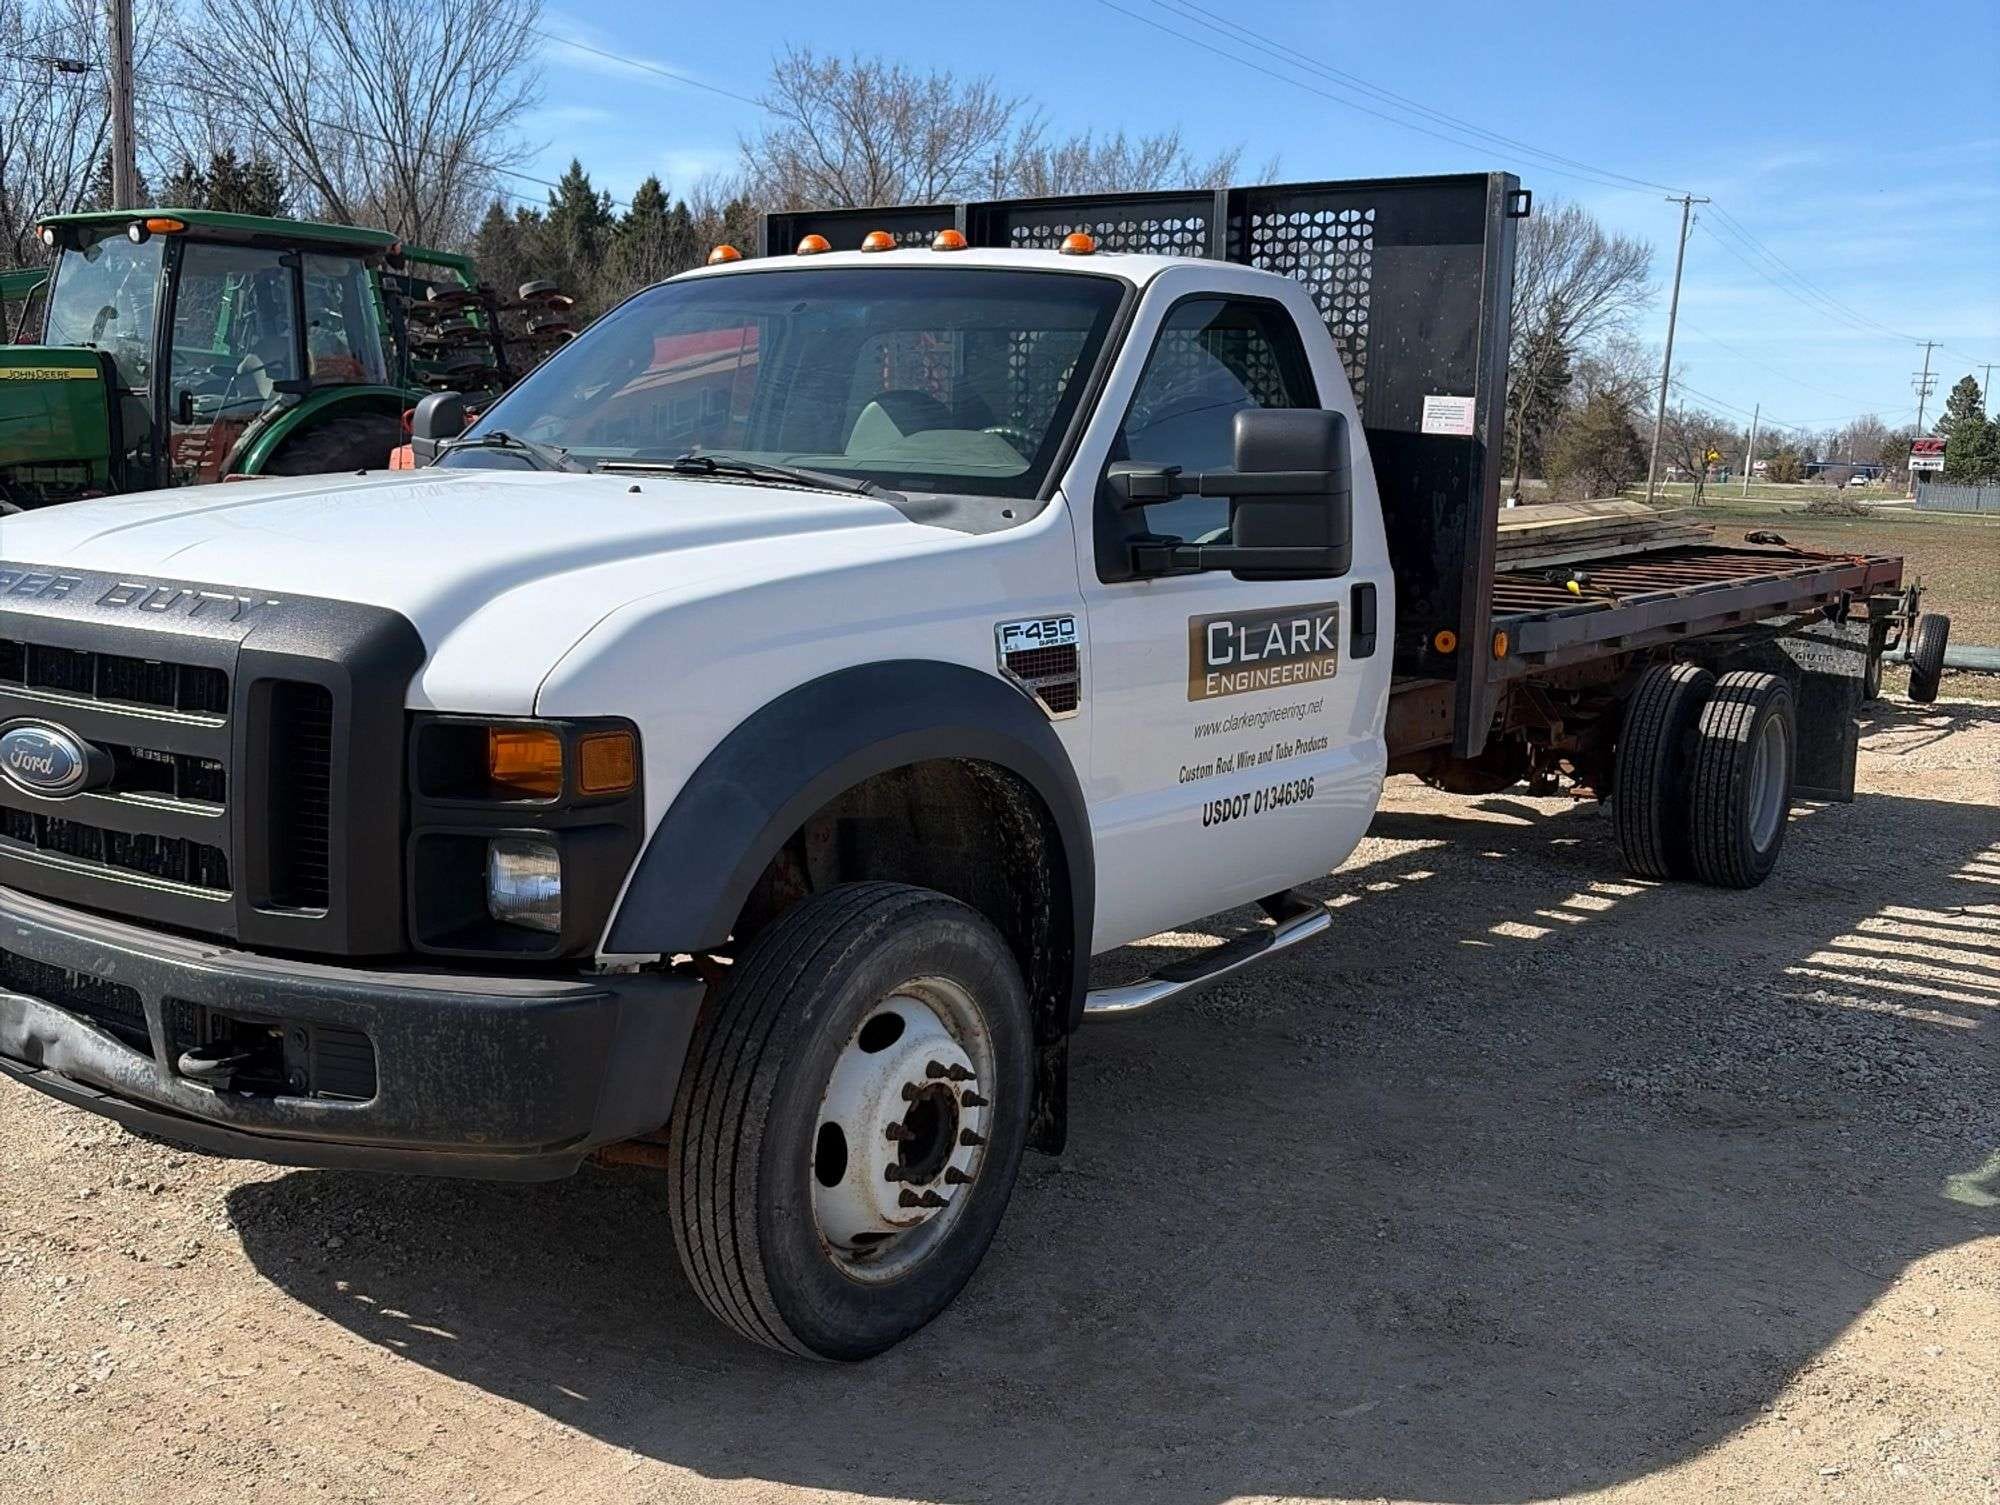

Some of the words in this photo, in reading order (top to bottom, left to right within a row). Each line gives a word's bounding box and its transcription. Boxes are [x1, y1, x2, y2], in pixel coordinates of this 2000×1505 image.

[8, 370, 36, 379] JOHN
[36, 369, 70, 378] DEERE
[95, 582, 280, 622] DUTY
[1207, 616, 1335, 666] CLARK
[1206, 658, 1335, 696] ENGINEERING
[1193, 699, 1324, 739] www.clarkengineering.net
[10, 745, 54, 774] Ford
[1178, 764, 1214, 784] Custom
[1215, 755, 1235, 775] Rod,
[1237, 750, 1256, 769] Wire
[1257, 745, 1274, 762] and
[1276, 741, 1293, 760] Tube
[1294, 736, 1328, 754] Products
[1202, 793, 1251, 827] USDOT
[1254, 776, 1315, 815] 01346396
